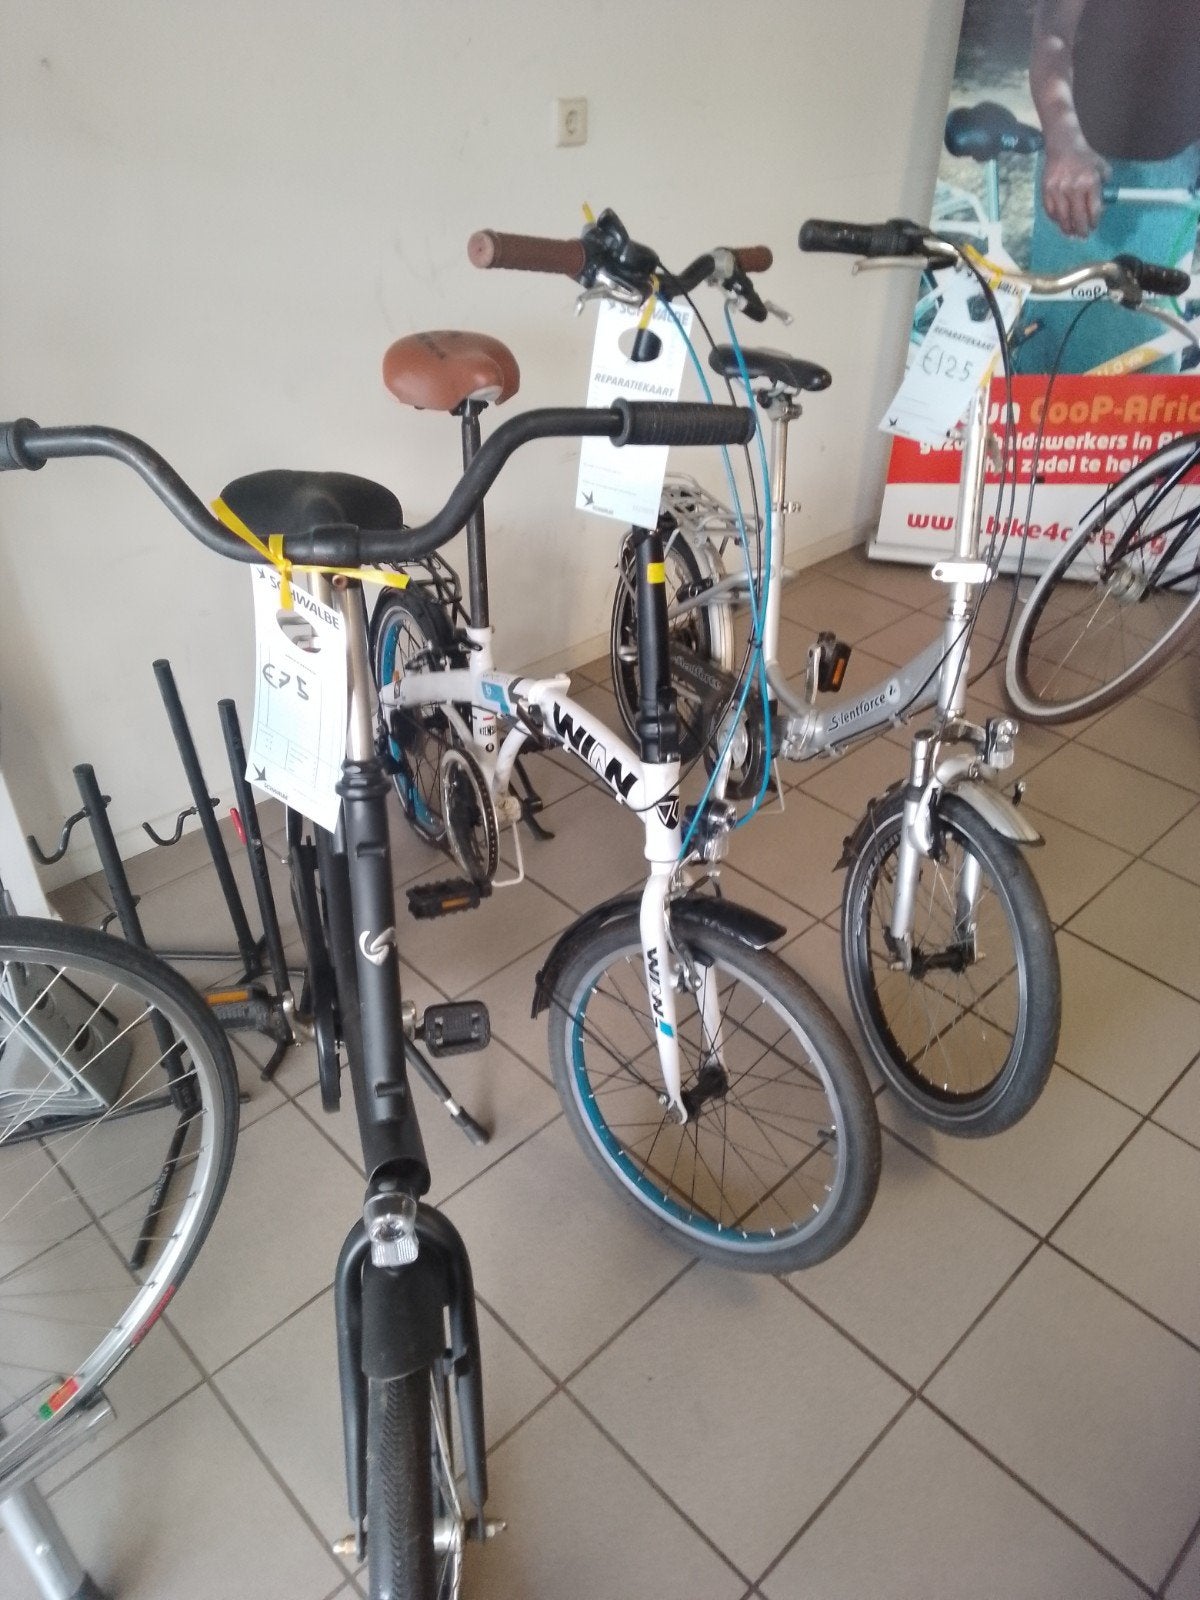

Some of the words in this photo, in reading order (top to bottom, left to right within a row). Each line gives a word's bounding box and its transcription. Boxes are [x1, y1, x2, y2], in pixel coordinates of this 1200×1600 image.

[594, 372, 675, 398] REPARATIEKAART
[1080, 456, 1101, 473] te
[828, 694, 886, 732] Slentforce
